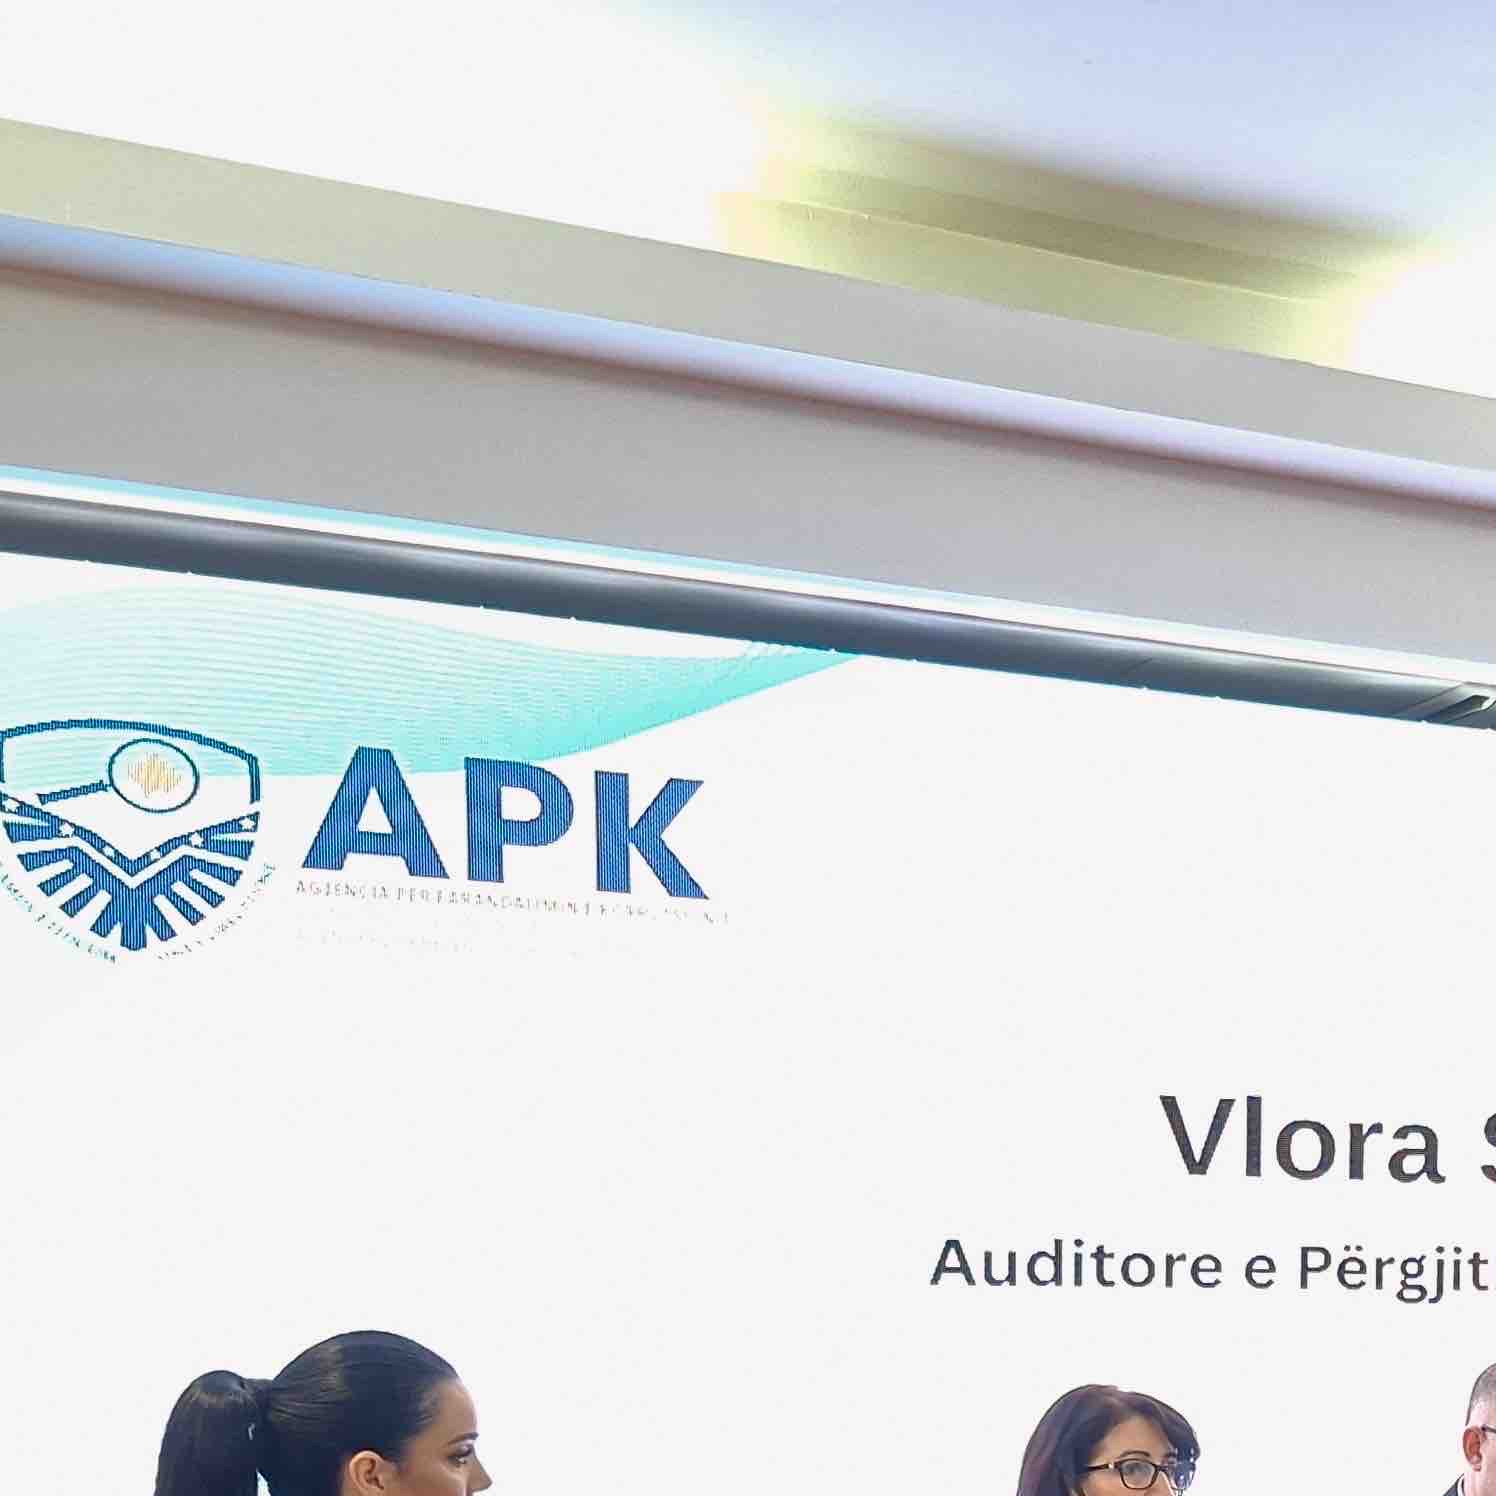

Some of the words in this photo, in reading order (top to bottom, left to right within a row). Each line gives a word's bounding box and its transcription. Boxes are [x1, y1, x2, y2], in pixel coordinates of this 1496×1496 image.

[301, 745, 710, 900] APK
[1159, 1094, 1446, 1184] Vlora
[930, 1238, 1222, 1289] Auditore
[1244, 1255, 1277, 1289] e
